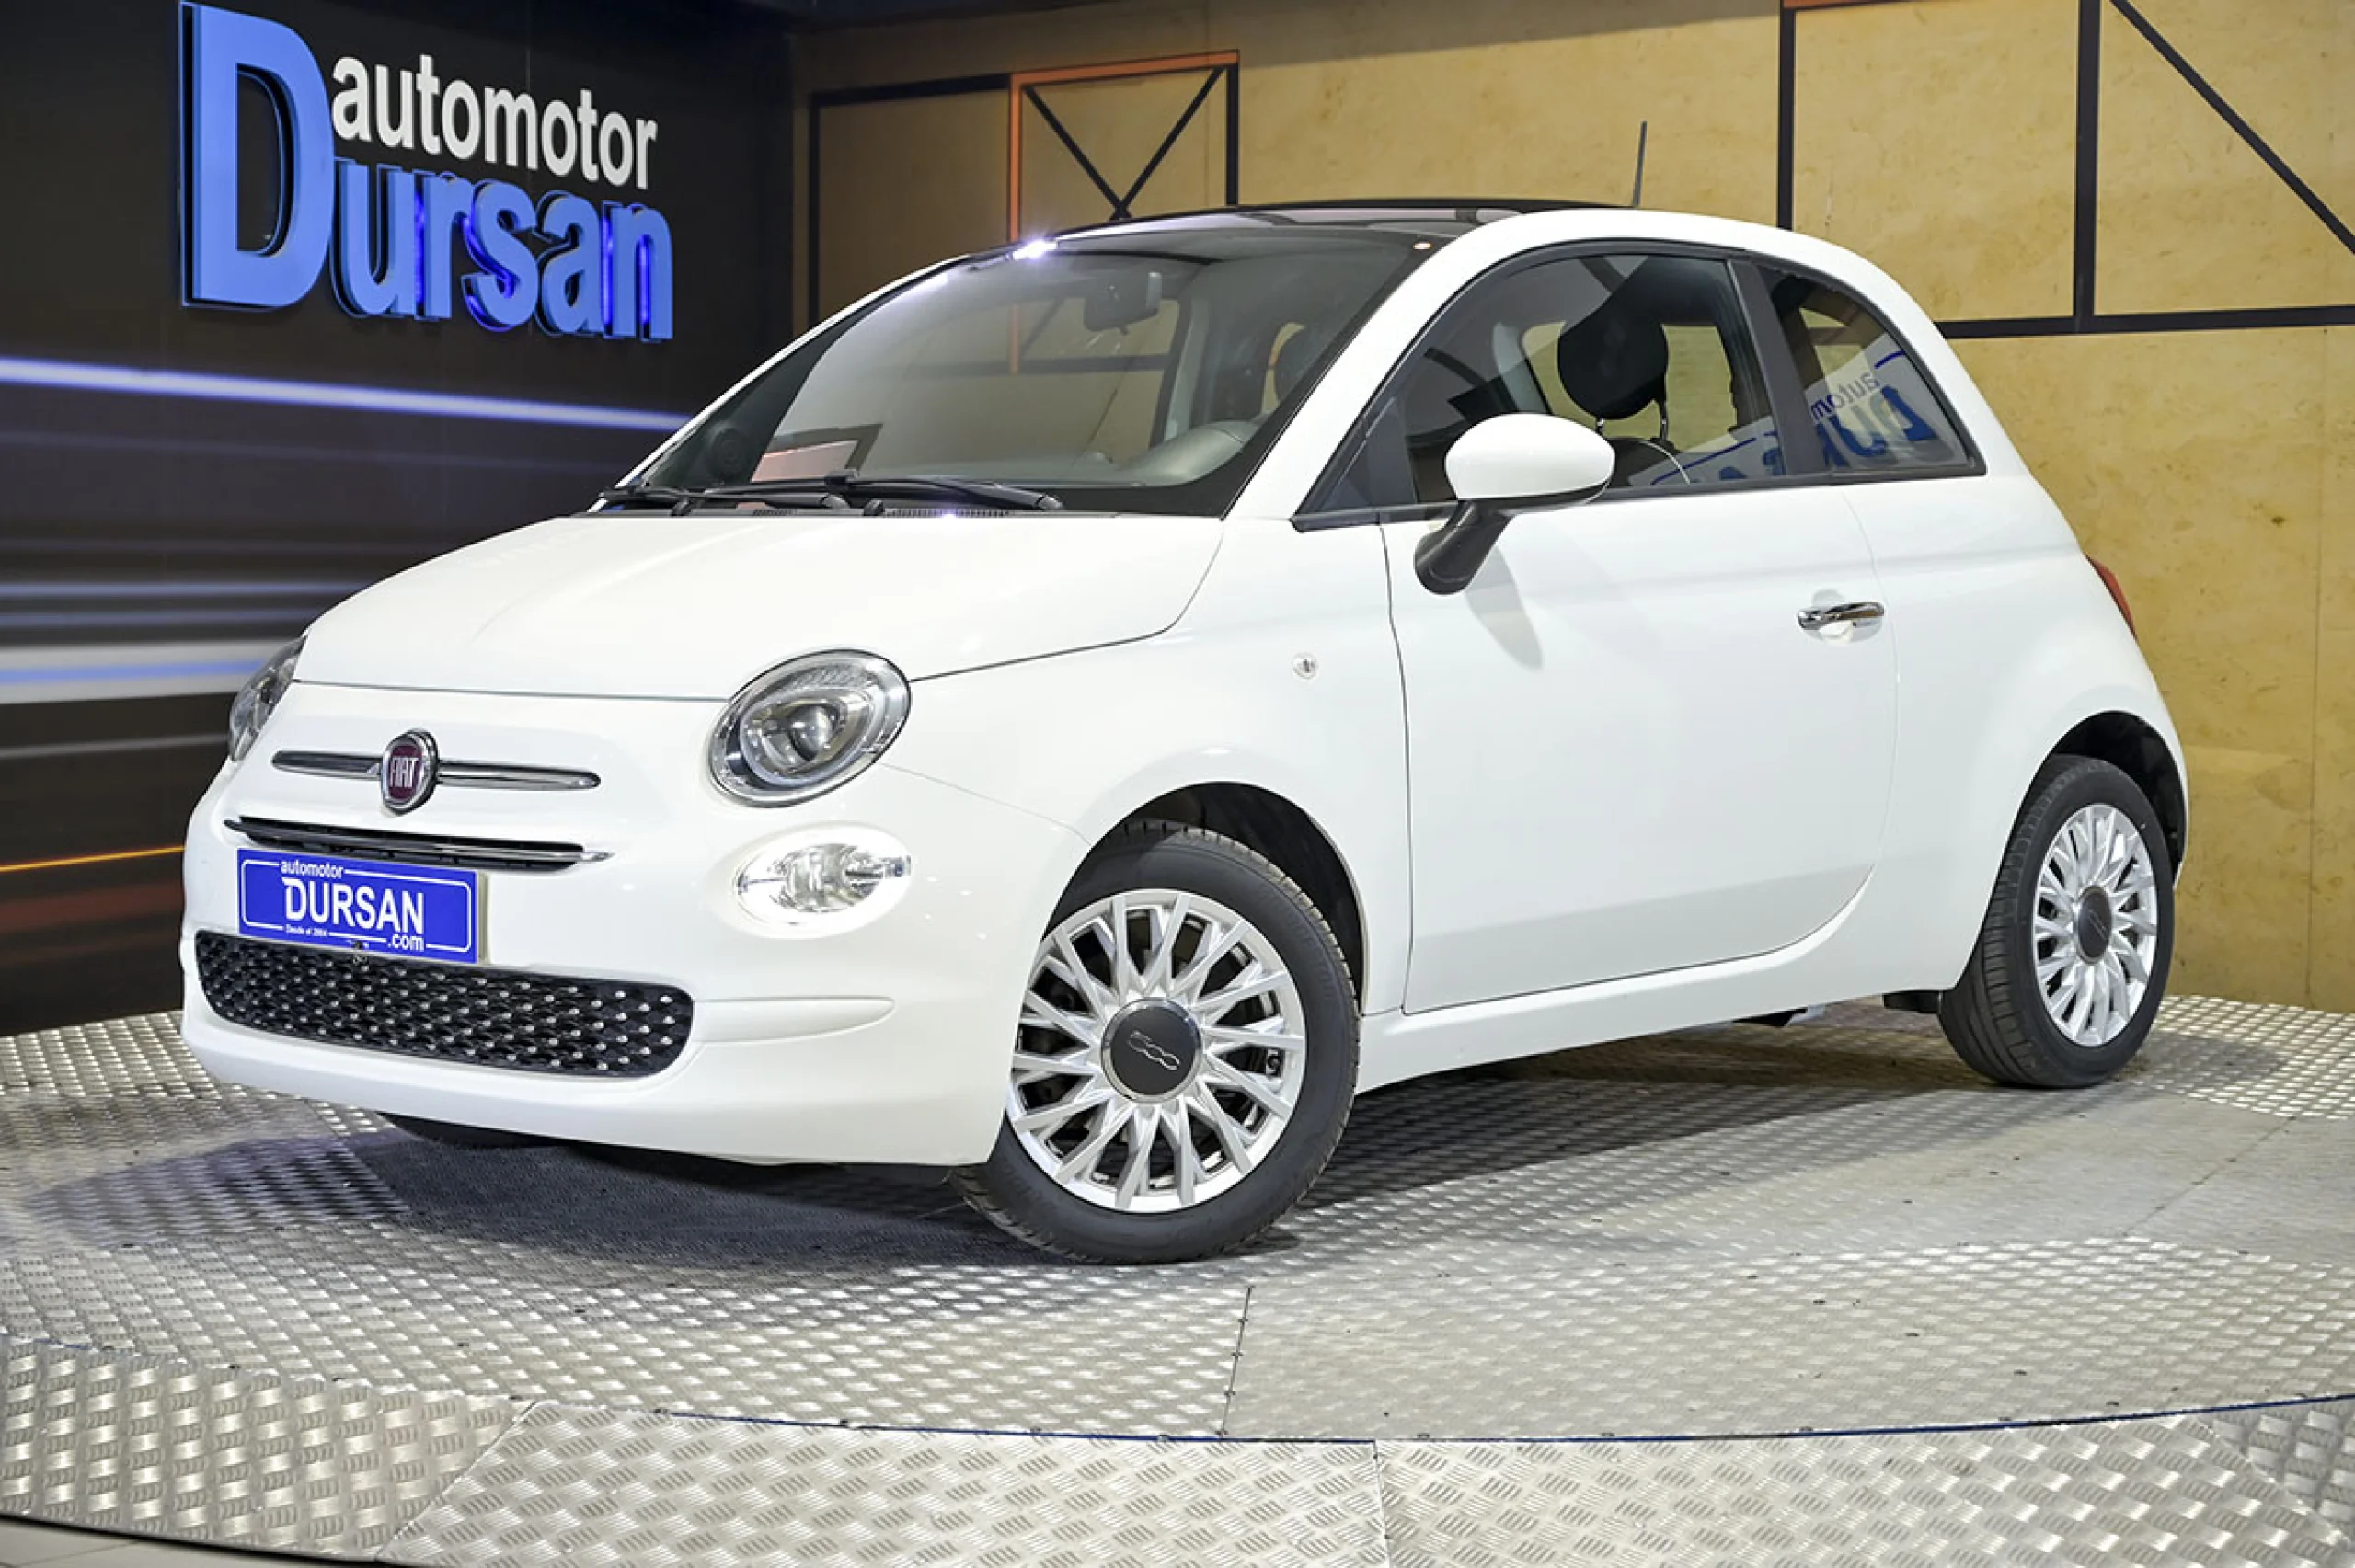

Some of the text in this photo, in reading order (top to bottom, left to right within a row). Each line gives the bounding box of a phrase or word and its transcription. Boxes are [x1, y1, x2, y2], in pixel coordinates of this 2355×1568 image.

[331, 54, 658, 189] automotor
[180, 2, 673, 342] Dursan
[390, 757, 419, 788] FIAT
[280, 859, 344, 879] automotor
[281, 876, 425, 935] DURSAN
[387, 934, 425, 952] .com
